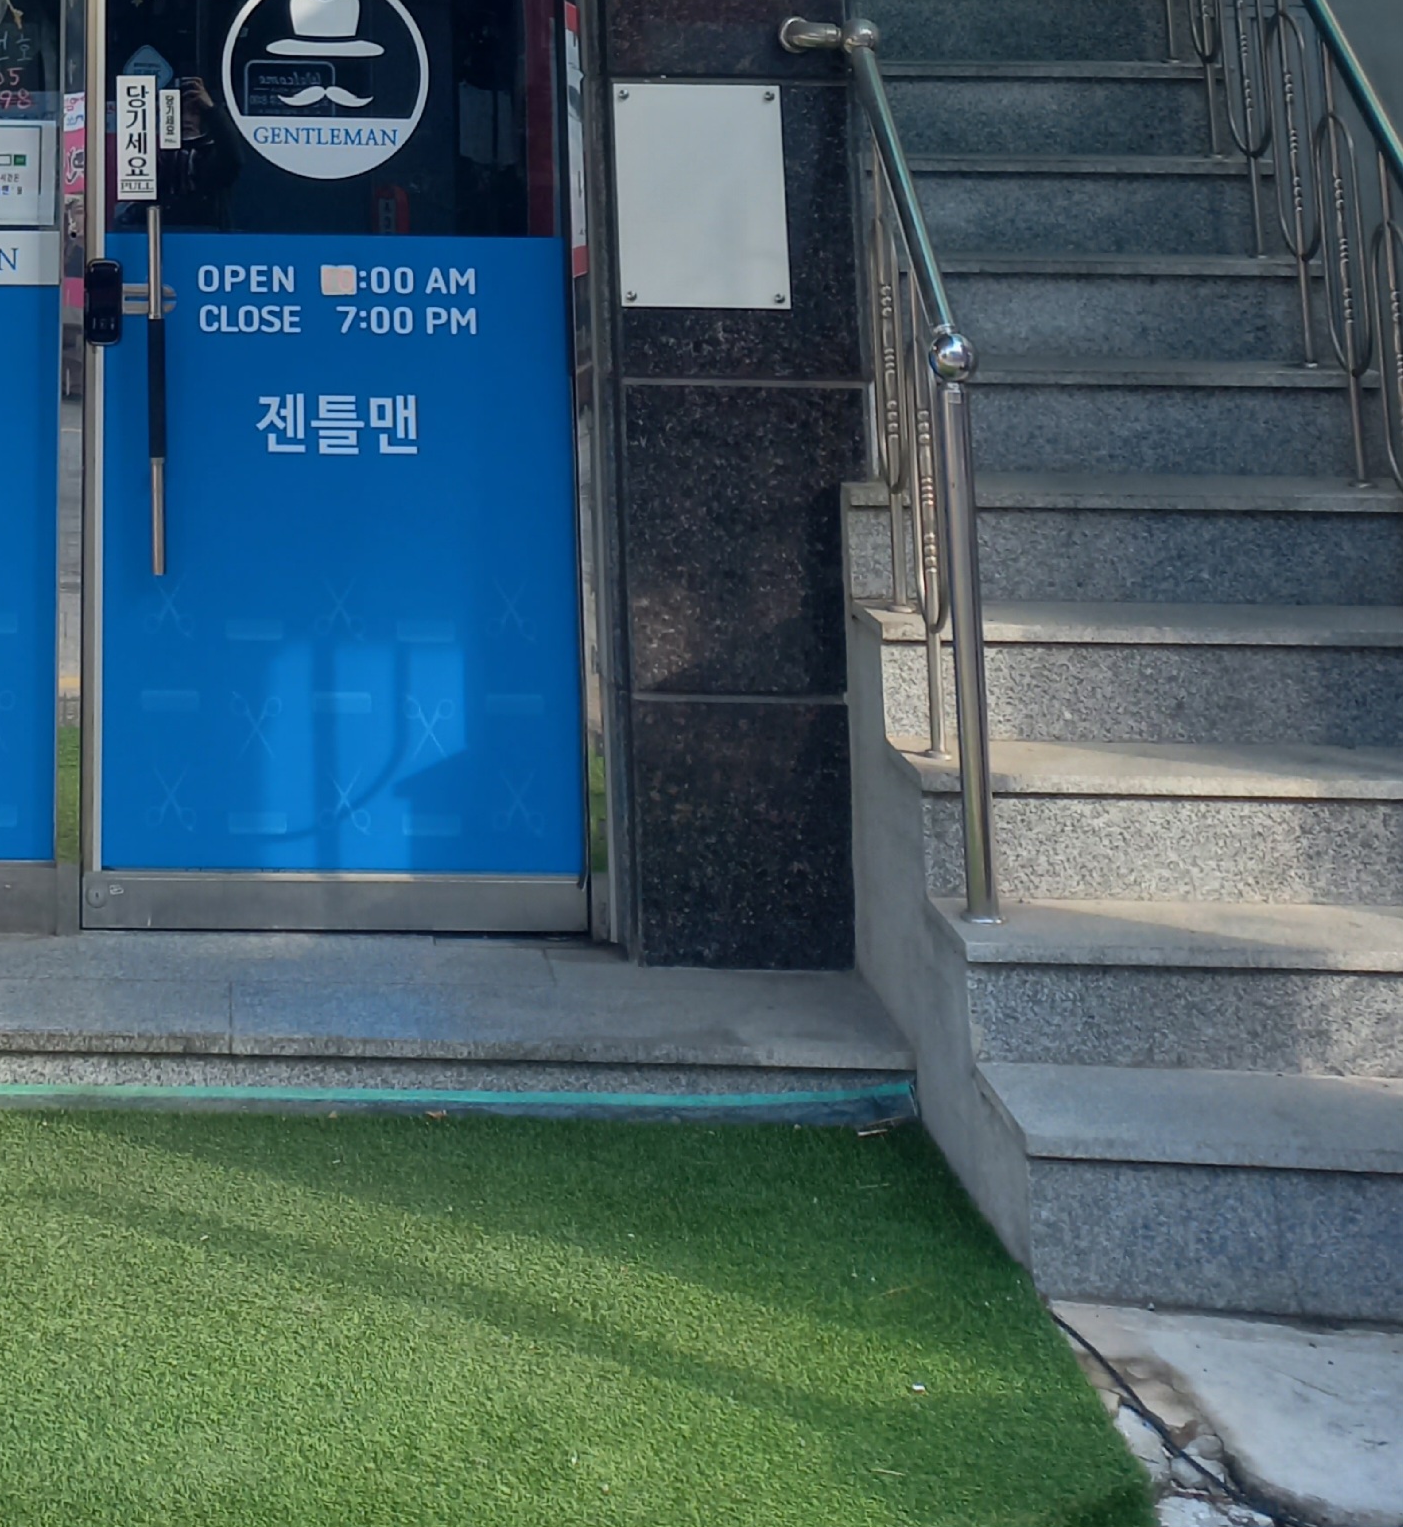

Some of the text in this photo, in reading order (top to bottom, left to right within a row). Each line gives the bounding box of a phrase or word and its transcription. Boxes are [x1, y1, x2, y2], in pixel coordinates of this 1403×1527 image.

[125, 85, 150, 177] 당기세요
[253, 126, 398, 147] GENTLEMAN
[120, 182, 154, 191] PULL
[198, 264, 295, 293] OPEN
[425, 267, 476, 295] AM
[199, 304, 477, 335] CLOSE 7:00 PM
[256, 393, 419, 455] 젠틀맨
